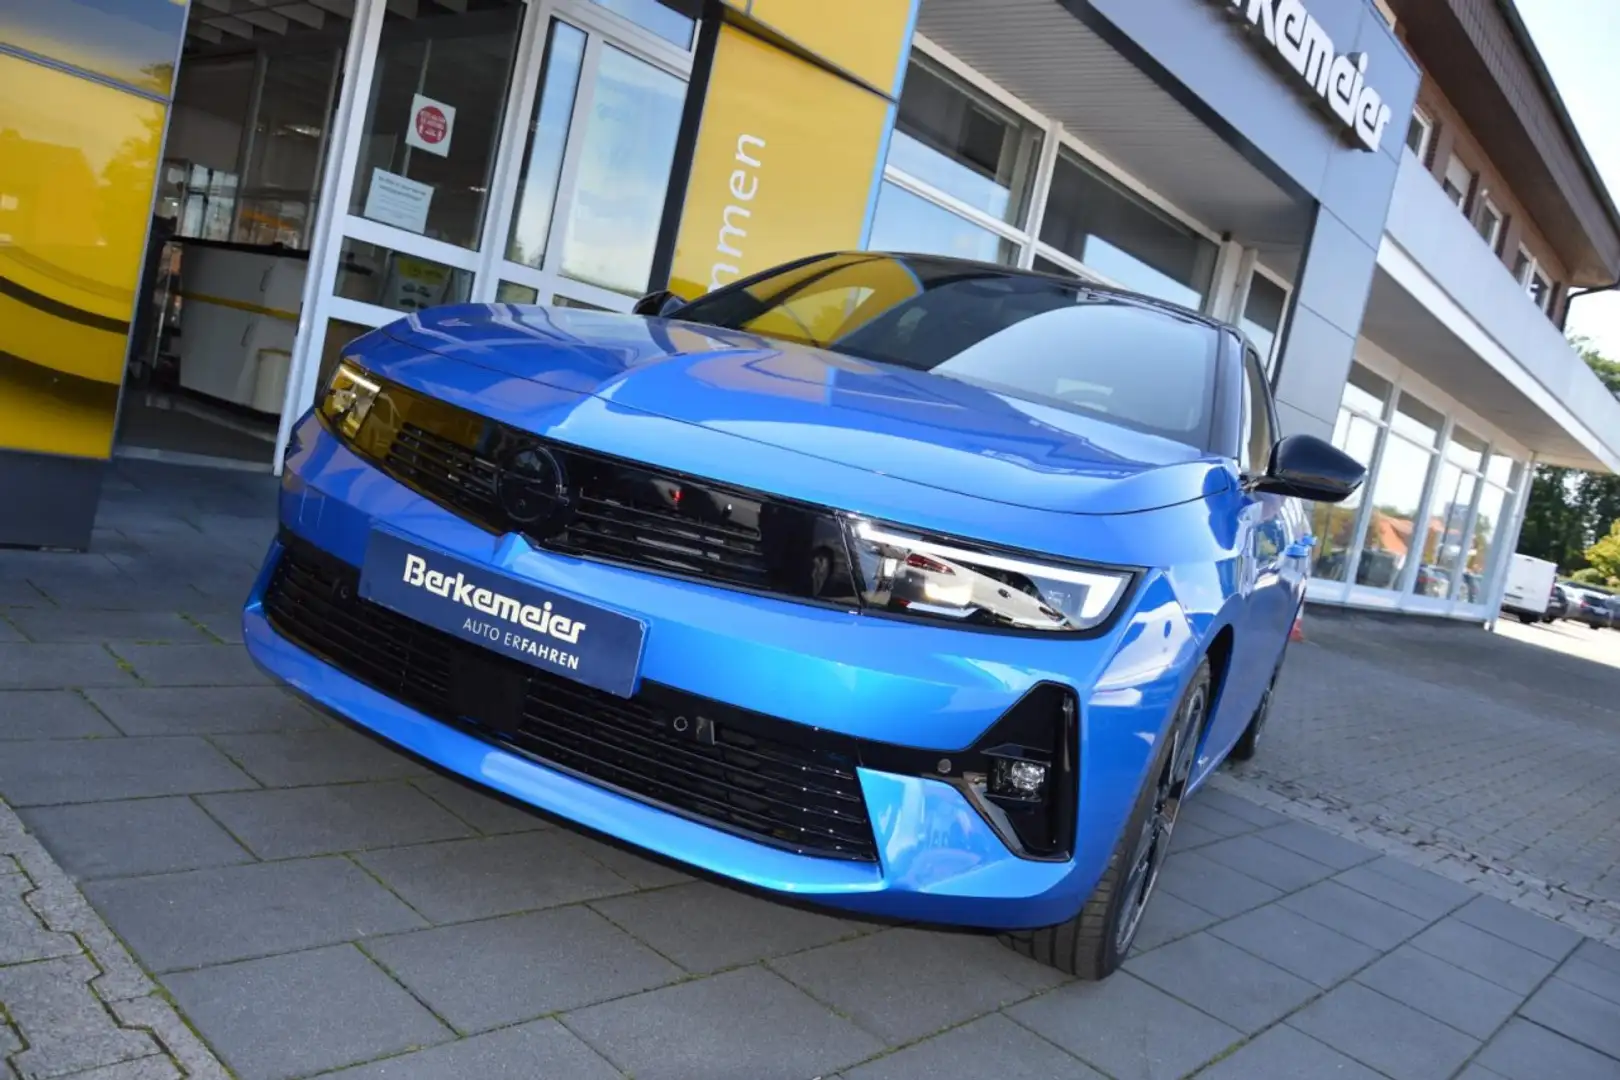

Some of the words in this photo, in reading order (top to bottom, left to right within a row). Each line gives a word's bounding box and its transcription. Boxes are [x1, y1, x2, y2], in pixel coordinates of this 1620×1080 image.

[1231, 0, 1392, 152] emeier
[403, 553, 586, 644] Berkemeier
[462, 617, 500, 641] AUTO
[504, 631, 580, 670] ERFAHREN
